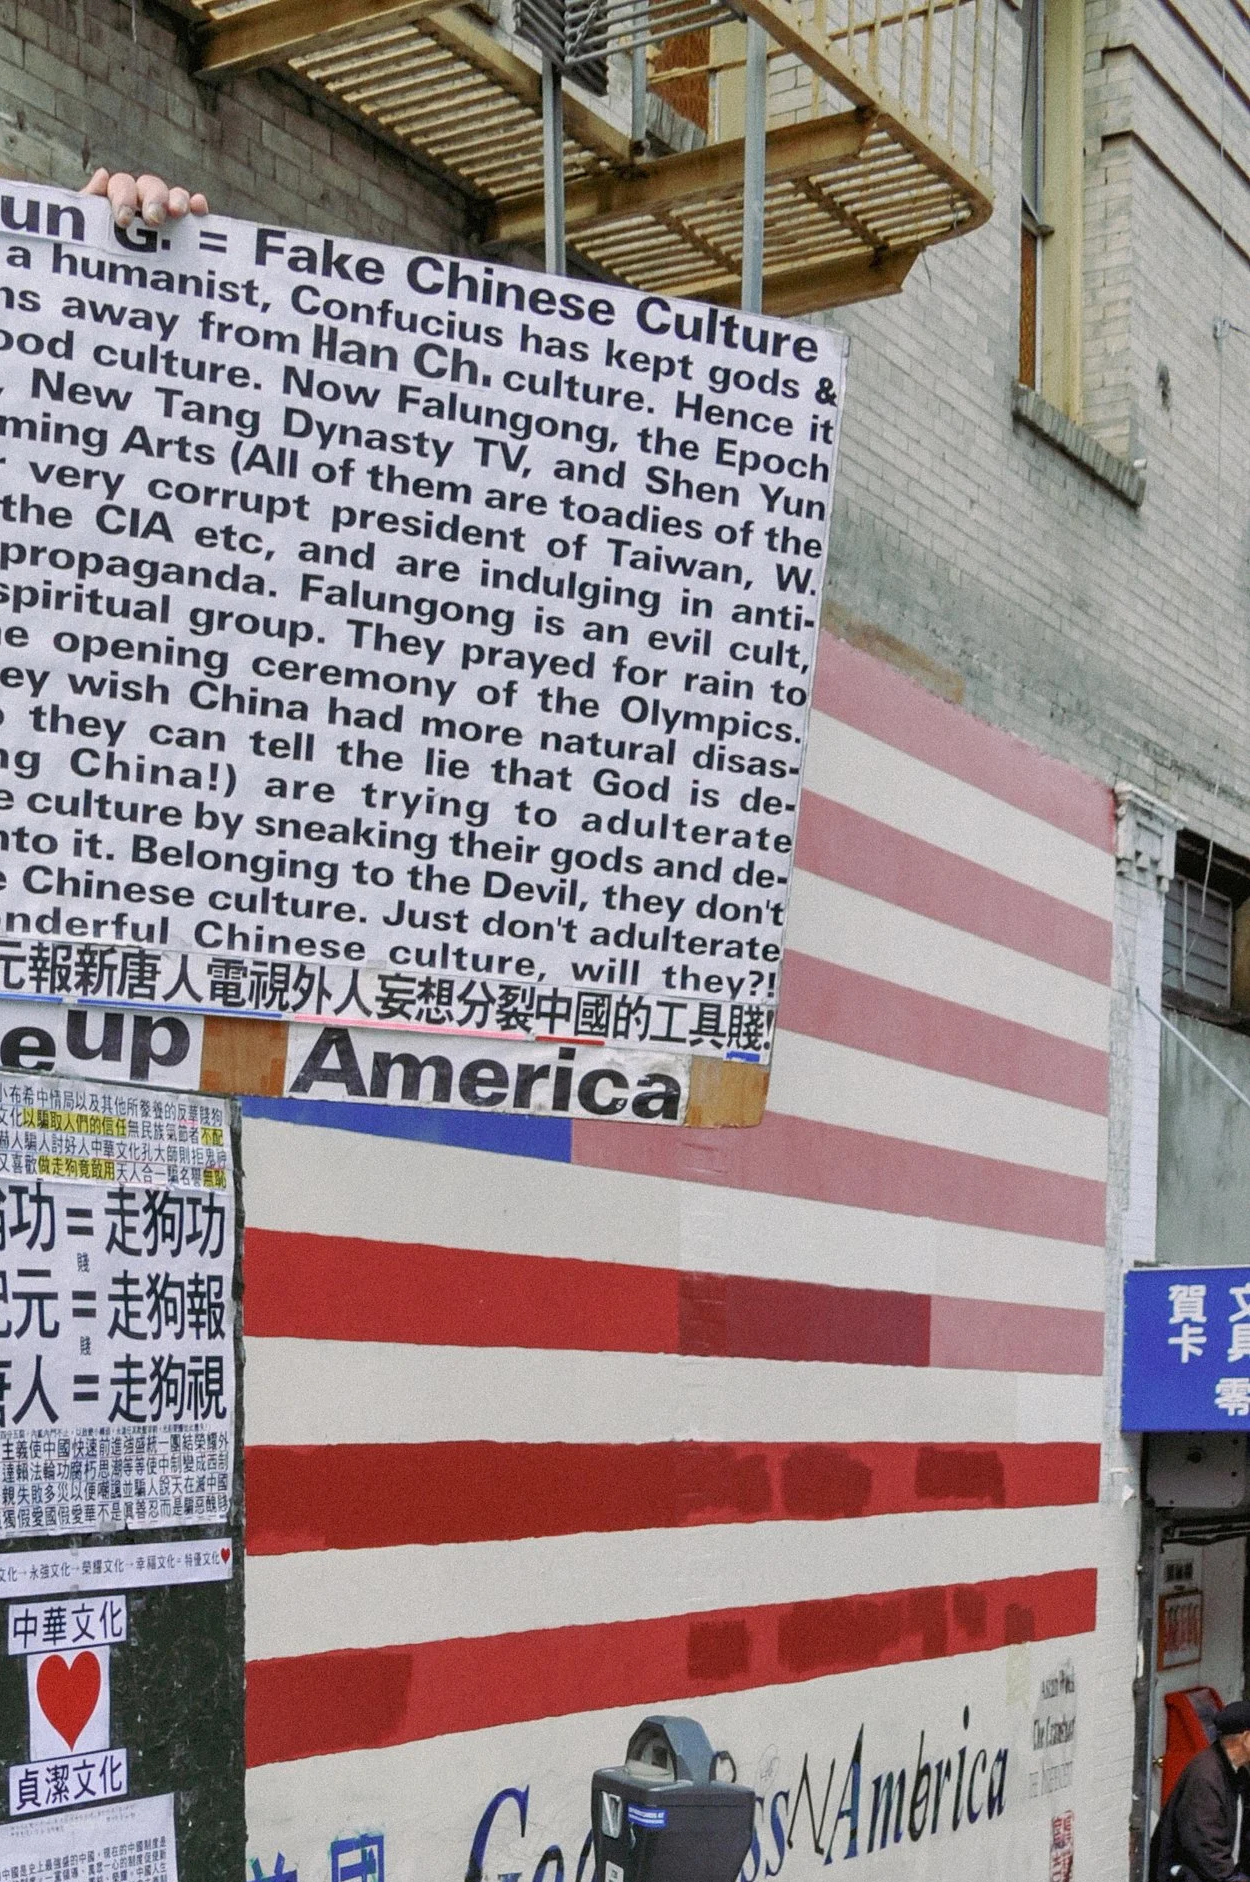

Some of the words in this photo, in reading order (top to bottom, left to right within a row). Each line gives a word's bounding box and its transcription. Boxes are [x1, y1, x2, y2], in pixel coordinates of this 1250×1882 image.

[7, 246, 30, 268] a
[53, 242, 270, 312] humanist,
[292, 285, 502, 347] Confucius
[521, 324, 588, 361] has
[606, 339, 693, 382] kept
[709, 366, 799, 398] gods
[815, 378, 837, 406] &
[256, 229, 384, 284] Fake
[407, 259, 614, 325] Chinese
[637, 296, 817, 362] Culture
[94, 344, 261, 389] culture.
[283, 366, 380, 407] Now
[399, 385, 617, 452] Falungong,
[637, 427, 699, 460] the
[716, 438, 829, 482] Epoch
[121, 426, 214, 465] Arts
[231, 441, 298, 478] (All
[312, 458, 355, 486] of
[367, 465, 471, 504] them
[485, 489, 547, 515] are
[560, 496, 702, 539] toadies
[715, 520, 754, 546] of
[765, 526, 822, 558] the
[96, 505, 173, 542] CIA
[195, 525, 274, 560] etc,
[299, 542, 375, 570] and
[396, 555, 459, 582] are
[481, 559, 660, 617] indulging
[681, 588, 712, 618] in
[732, 605, 814, 631] anti-
[29, 704, 126, 747] they
[150, 725, 225, 751] can
[250, 731, 314, 761] tell
[337, 740, 402, 771] the
[426, 748, 469, 779] lie
[491, 758, 571, 791] that
[594, 769, 669, 802] God
[691, 780, 719, 807] is
[740, 787, 795, 815] de-
[74, 829, 114, 860] it.
[132, 835, 338, 888] Belonging
[352, 861, 393, 887] to
[407, 864, 470, 895] the
[484, 871, 587, 911] Devil,
[603, 885, 684, 922] they
[696, 894, 783, 926] don't
[195, 921, 365, 960] Chinese
[390, 943, 545, 981] culture,
[572, 958, 639, 985] will
[662, 965, 776, 997] they?!
[66, 1009, 191, 1081] up
[289, 1027, 682, 1120] America
[66, 1208, 94, 1236] =
[104, 1185, 226, 1258] 走狗功
[72, 1290, 97, 1318] =
[107, 1270, 226, 1340] 走狗報
[1168, 1284, 1207, 1363] 賀卡
[73, 1374, 99, 1401] =
[108, 1353, 227, 1424] 走狗視
[12, 1604, 124, 1647] 中華文化
[17, 1756, 123, 1809] 貞潔文化
